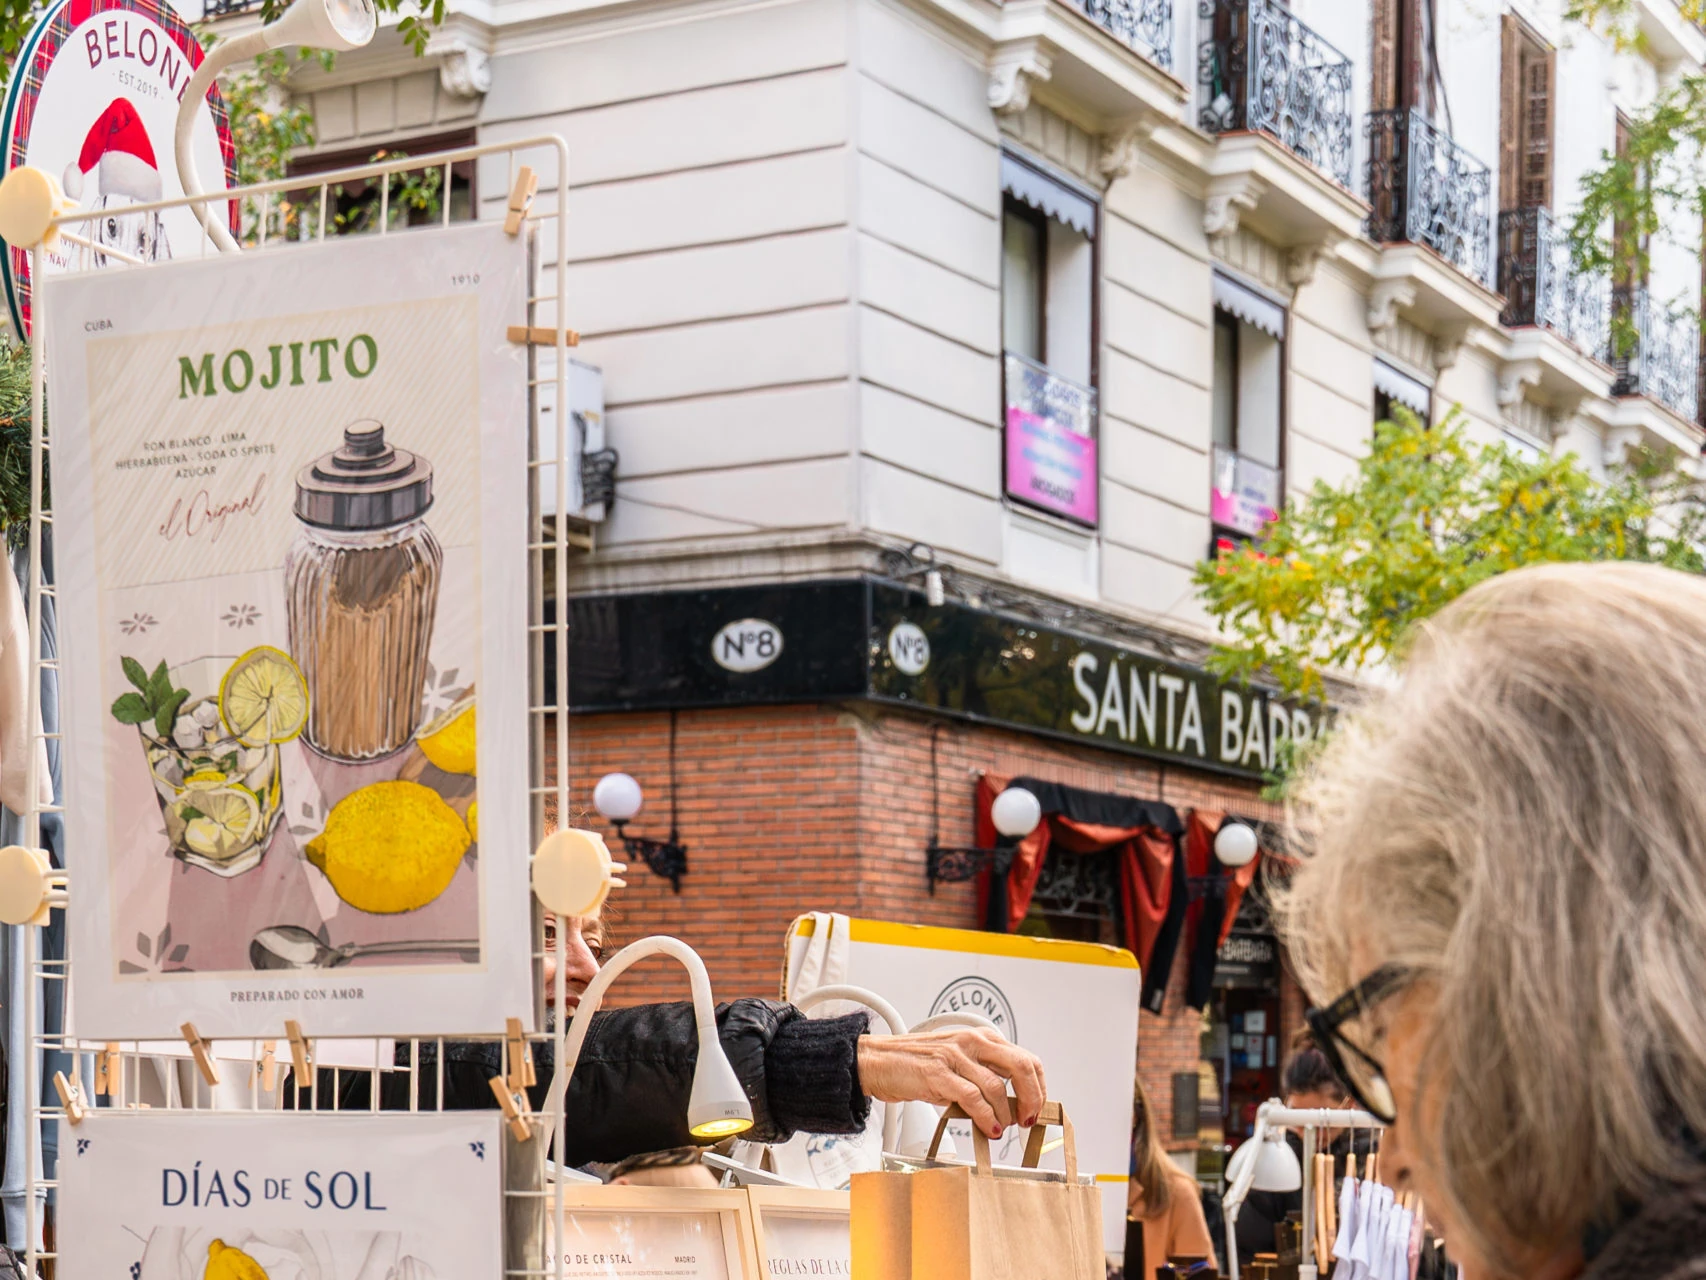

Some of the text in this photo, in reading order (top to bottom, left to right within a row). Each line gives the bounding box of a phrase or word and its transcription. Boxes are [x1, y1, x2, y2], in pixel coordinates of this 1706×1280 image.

[85, 320, 112, 333] CUBA
[178, 334, 378, 399] MOJITO
[144, 432, 246, 451] RON BLANCO LIMA
[116, 454, 187, 469] HIERBABUENA
[197, 448, 226, 461] SODA
[241, 444, 276, 457] SPRITE
[1071, 651, 1206, 757] SANTA
[230, 988, 364, 1002] PREPARADO CON AMOR
[941, 990, 1004, 1026] ELONE
[163, 1160, 387, 1210] DÍAS DE SOL
[576, 1254, 589, 1264] DE
